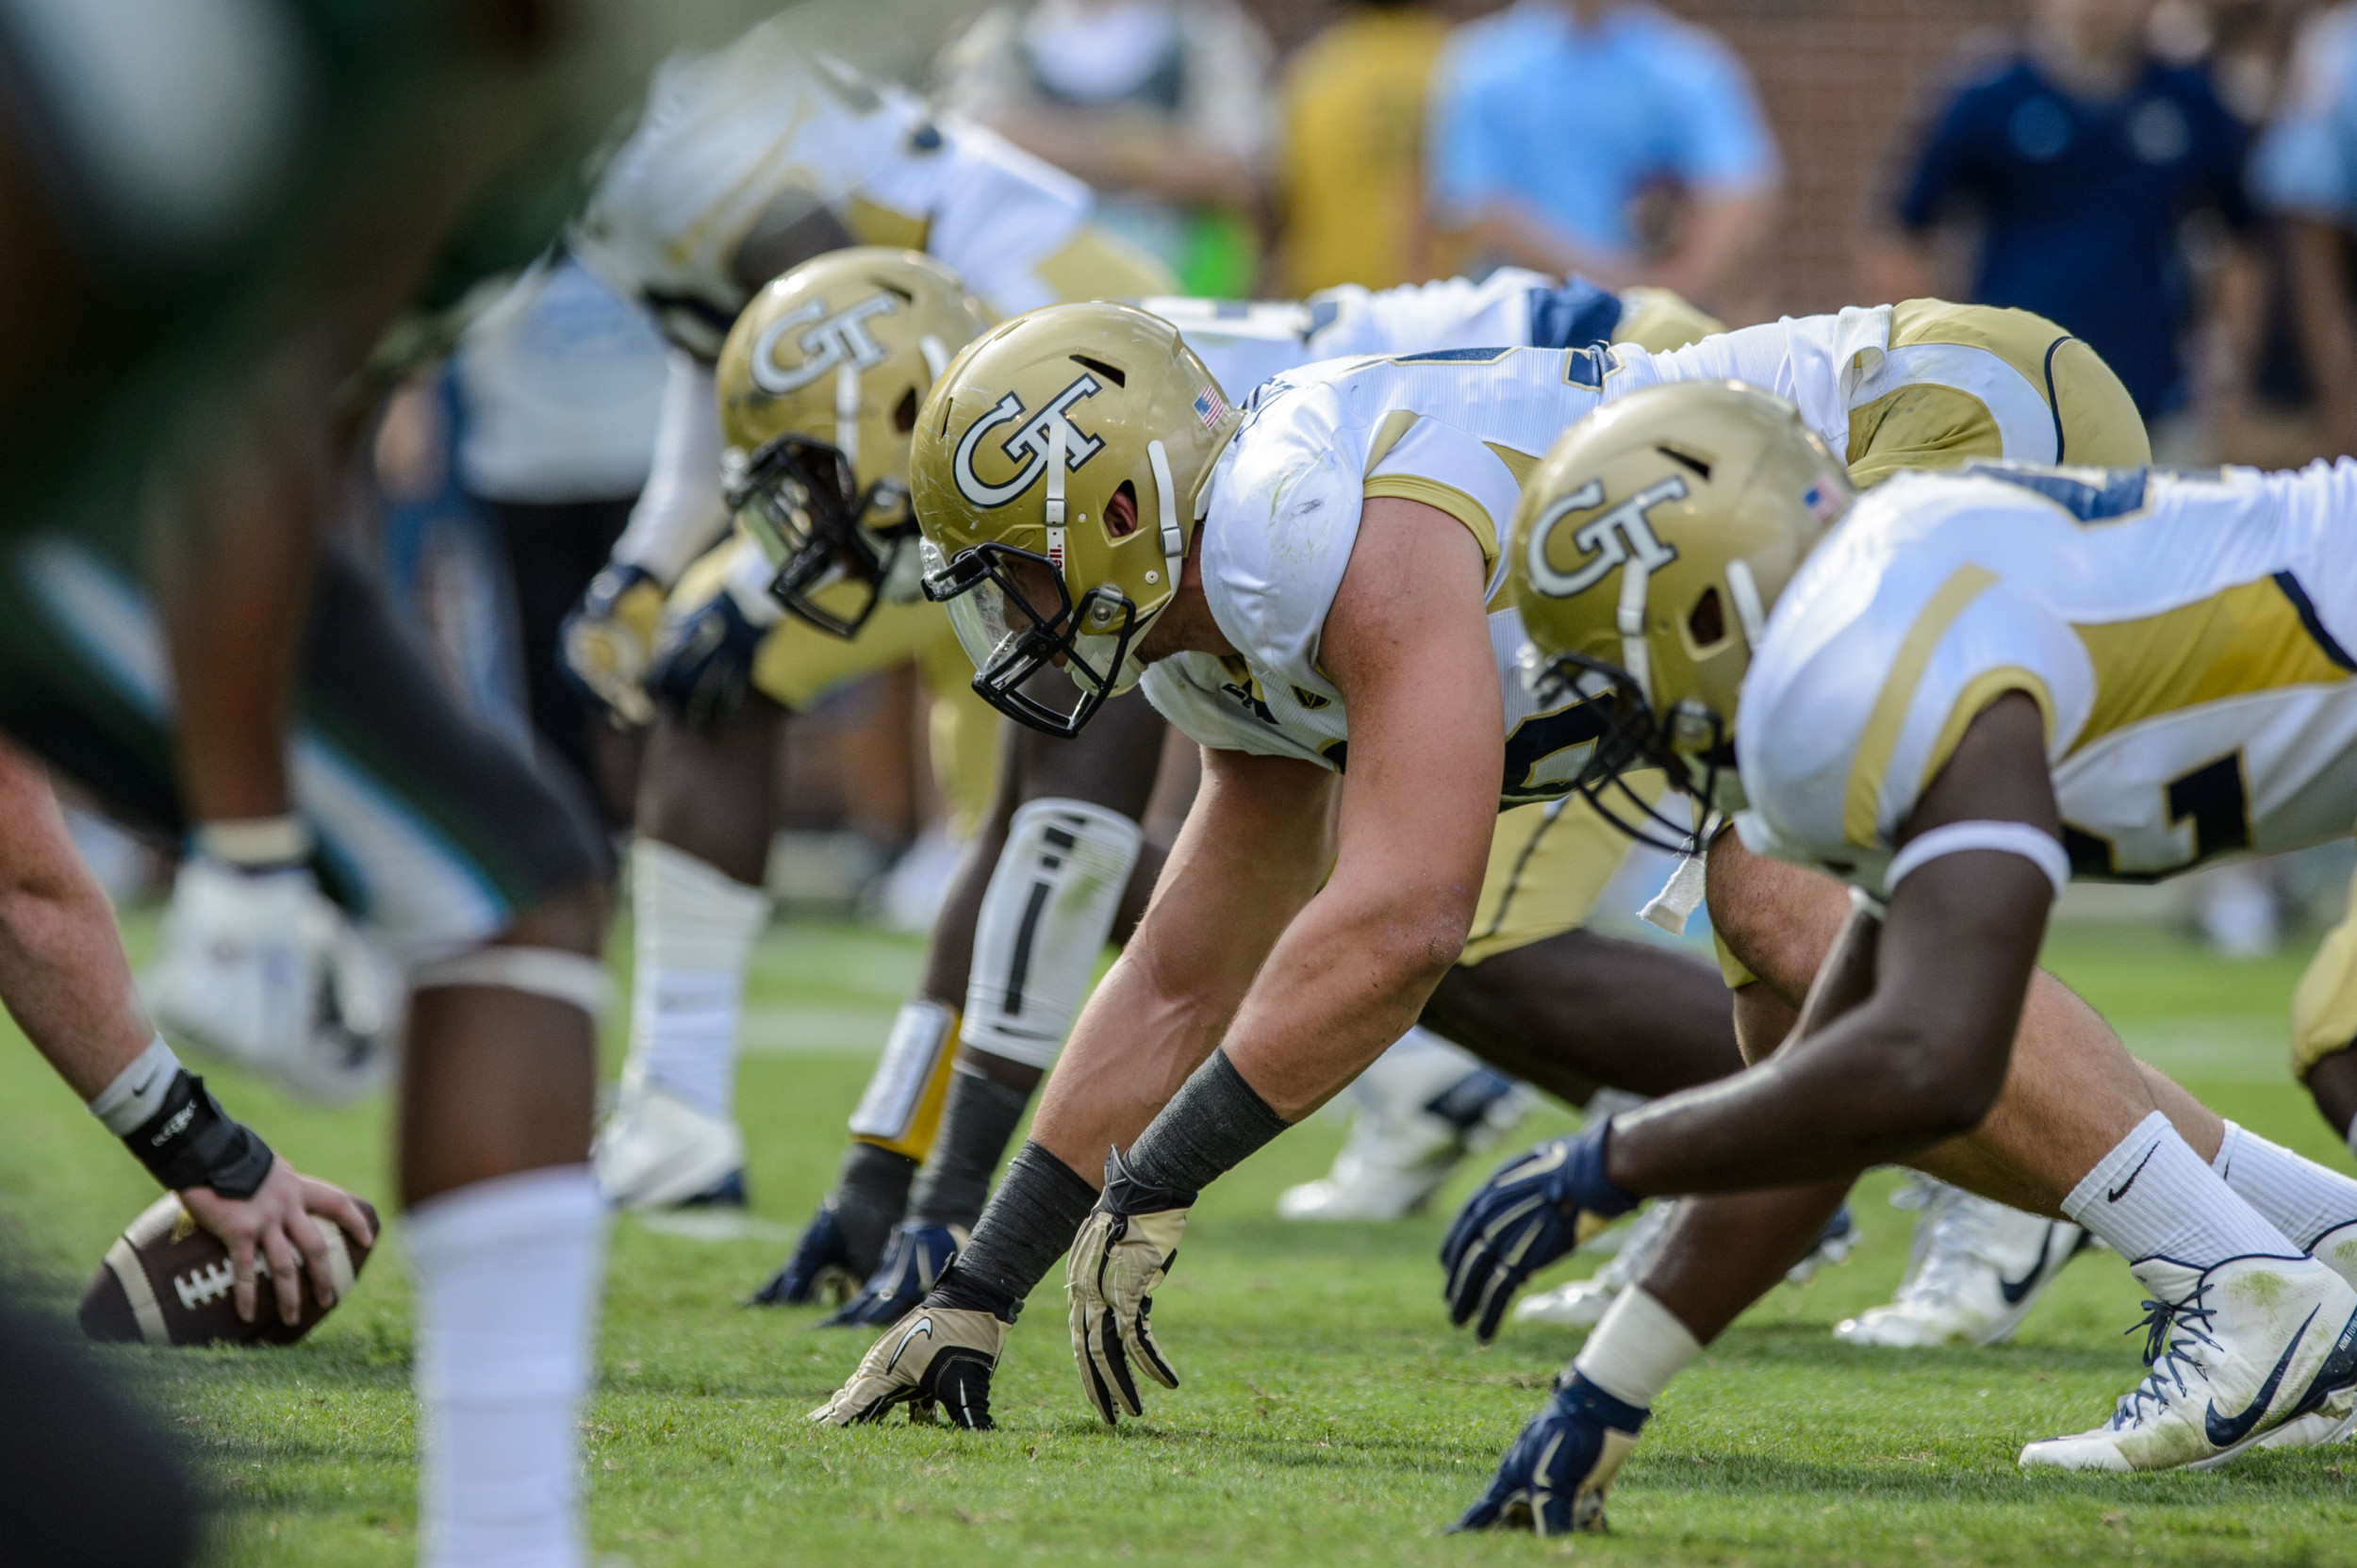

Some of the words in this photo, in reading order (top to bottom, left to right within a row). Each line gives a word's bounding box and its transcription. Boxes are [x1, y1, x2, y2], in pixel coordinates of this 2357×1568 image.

[751, 292, 898, 395] GT
[953, 372, 1106, 509] GT
[1526, 474, 1689, 600] GT
